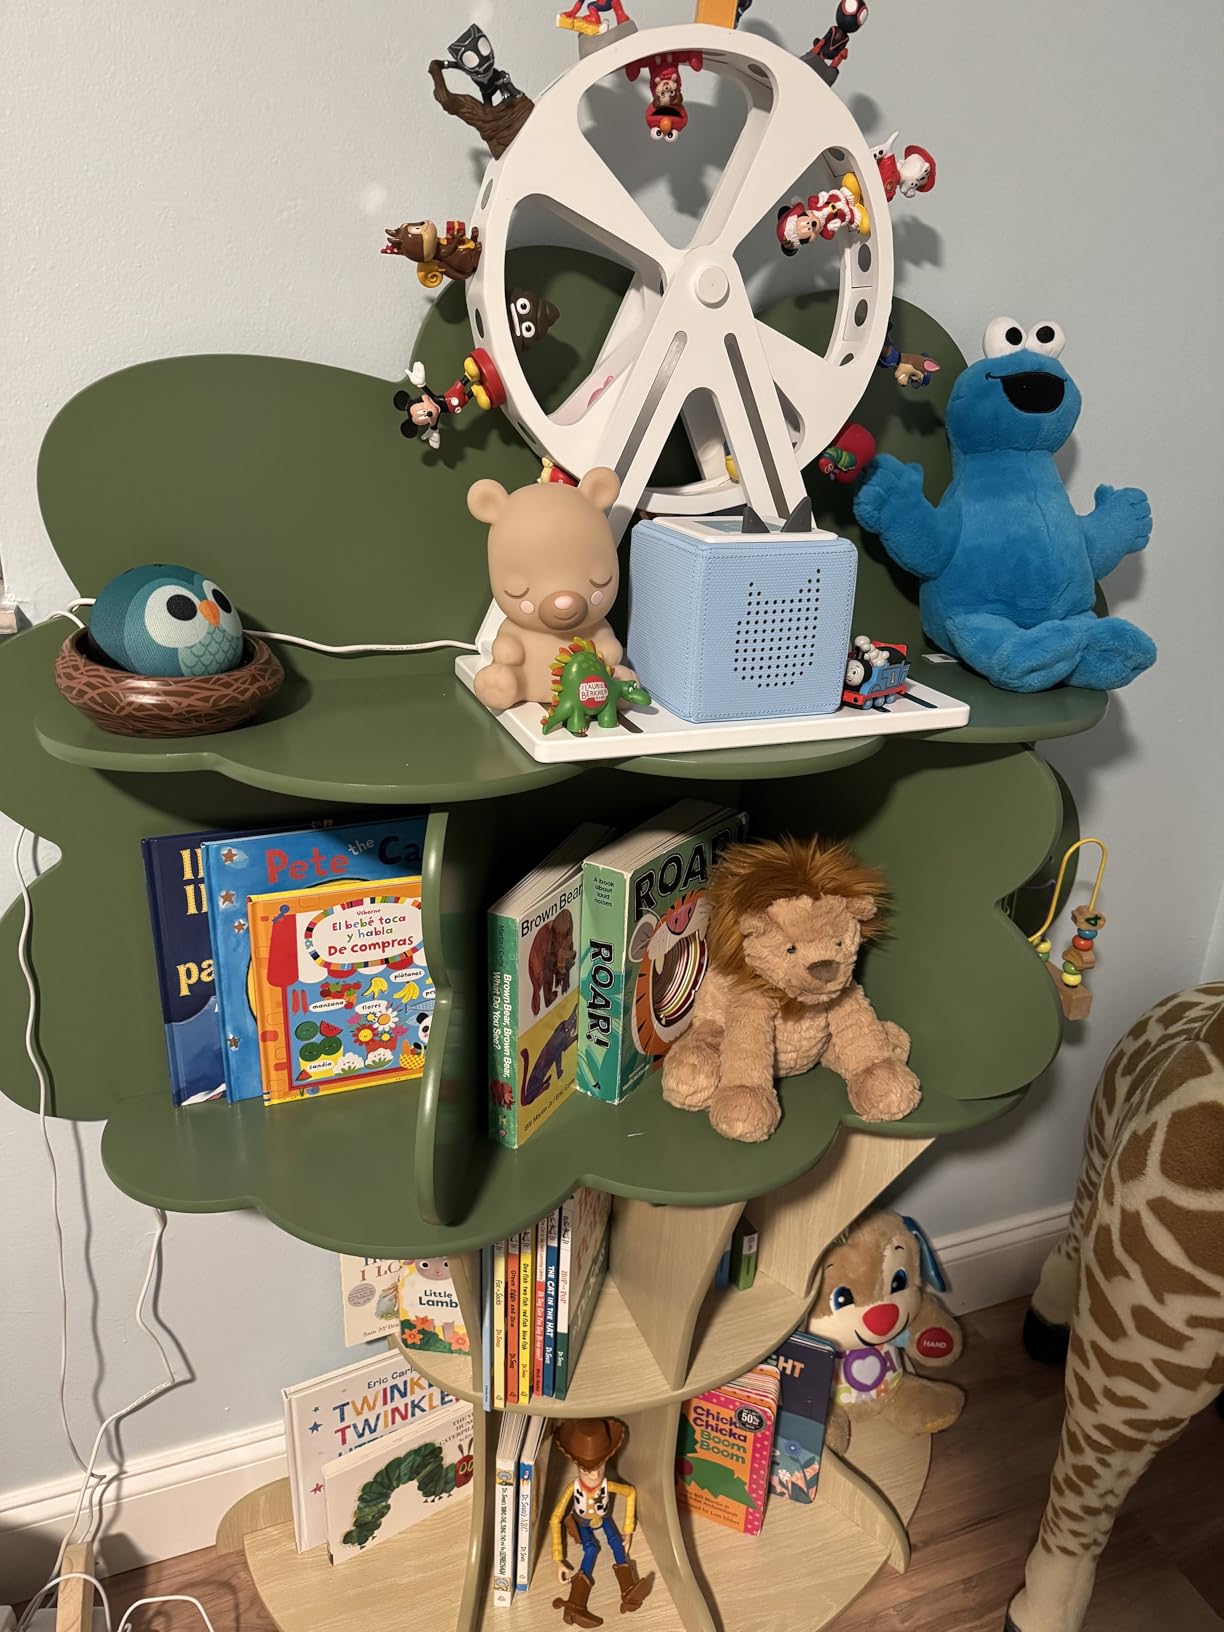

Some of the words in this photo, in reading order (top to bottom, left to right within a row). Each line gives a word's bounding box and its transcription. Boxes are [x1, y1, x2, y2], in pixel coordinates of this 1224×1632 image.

[266, 848, 349, 884] Pete
[348, 840, 375, 856] the
[594, 898, 612, 907] noises
[597, 891, 609, 900] loud
[522, 902, 558, 938] Brown
[559, 882, 583, 914] Bear
[332, 922, 342, 931] El
[345, 916, 374, 930] bebé
[380, 915, 406, 925] toca
[346, 933, 354, 943] y
[358, 927, 393, 938] habla
[328, 945, 347, 956] De
[350, 936, 414, 953] compras
[492, 972, 501, 994] What
[504, 974, 512, 1003] Brown
[493, 995, 501, 1008] Do
[586, 938, 614, 1050] ROAR!
[312, 1001, 344, 1009] manzana
[502, 1004, 511, 1026] Bear,
[493, 1011, 501, 1026] You
[493, 1028, 501, 1050] See?
[504, 1028, 512, 1055] Brown
[502, 1057, 511, 1078] Bear,
[360, 1270, 366, 1281] I
[418, 1296, 459, 1308] Lamb
[424, 1290, 452, 1298] Little
[547, 1297, 554, 1305] IN
[923, 1340, 947, 1348] HAND
[367, 1377, 388, 1389] Eric
[392, 1366, 416, 1380] Carl
[333, 1376, 434, 1423] TWINK
[693, 1406, 738, 1429] Chick
[693, 1417, 747, 1442] Chicka
[701, 1429, 747, 1454] Boom
[700, 1441, 746, 1464] Boom
